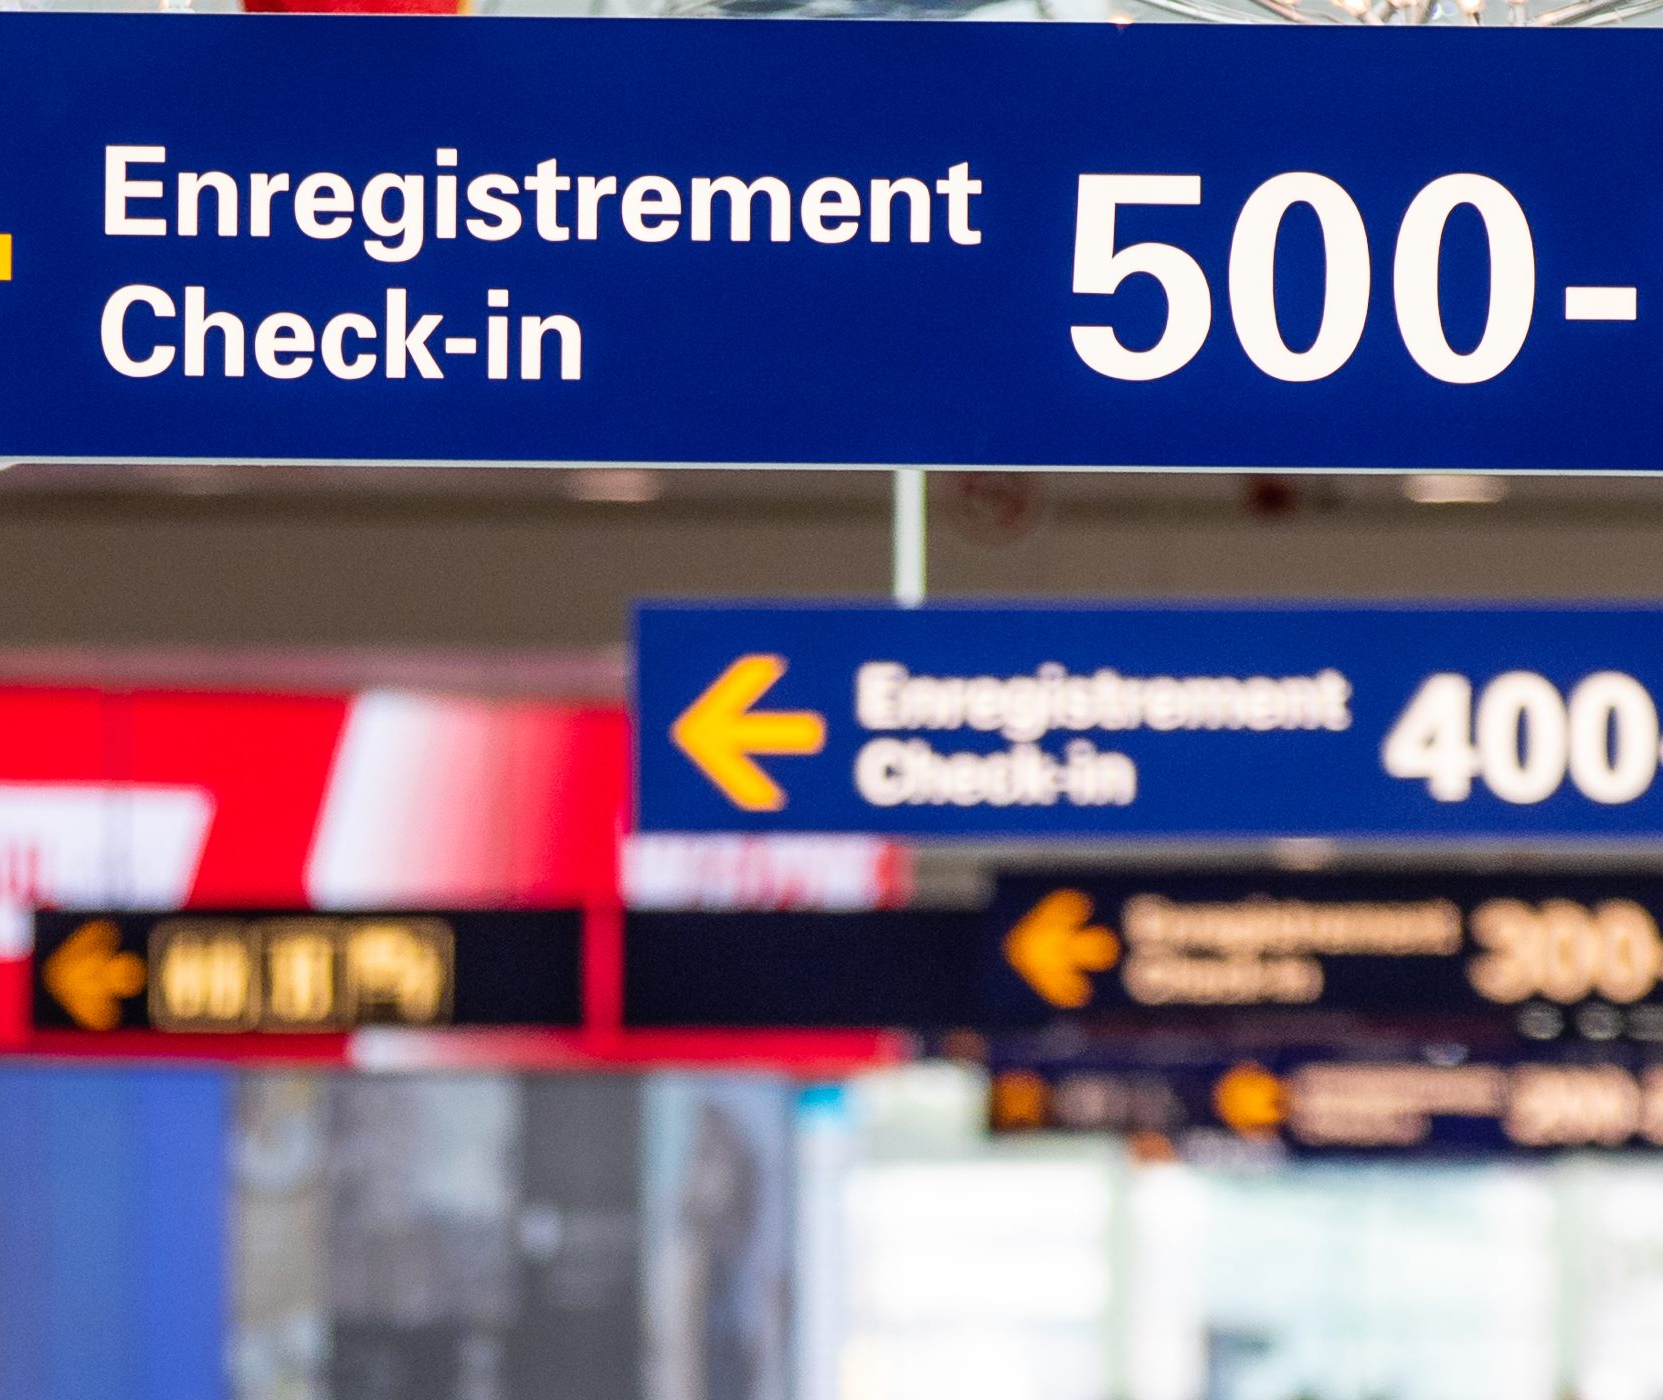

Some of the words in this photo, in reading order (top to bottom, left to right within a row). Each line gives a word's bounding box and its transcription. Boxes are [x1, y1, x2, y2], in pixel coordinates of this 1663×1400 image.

[103, 144, 984, 264] Enregistrement
[99, 283, 583, 382] Check-in
[856, 661, 1352, 740] Enregistrement
[854, 738, 1138, 806] Check-in
